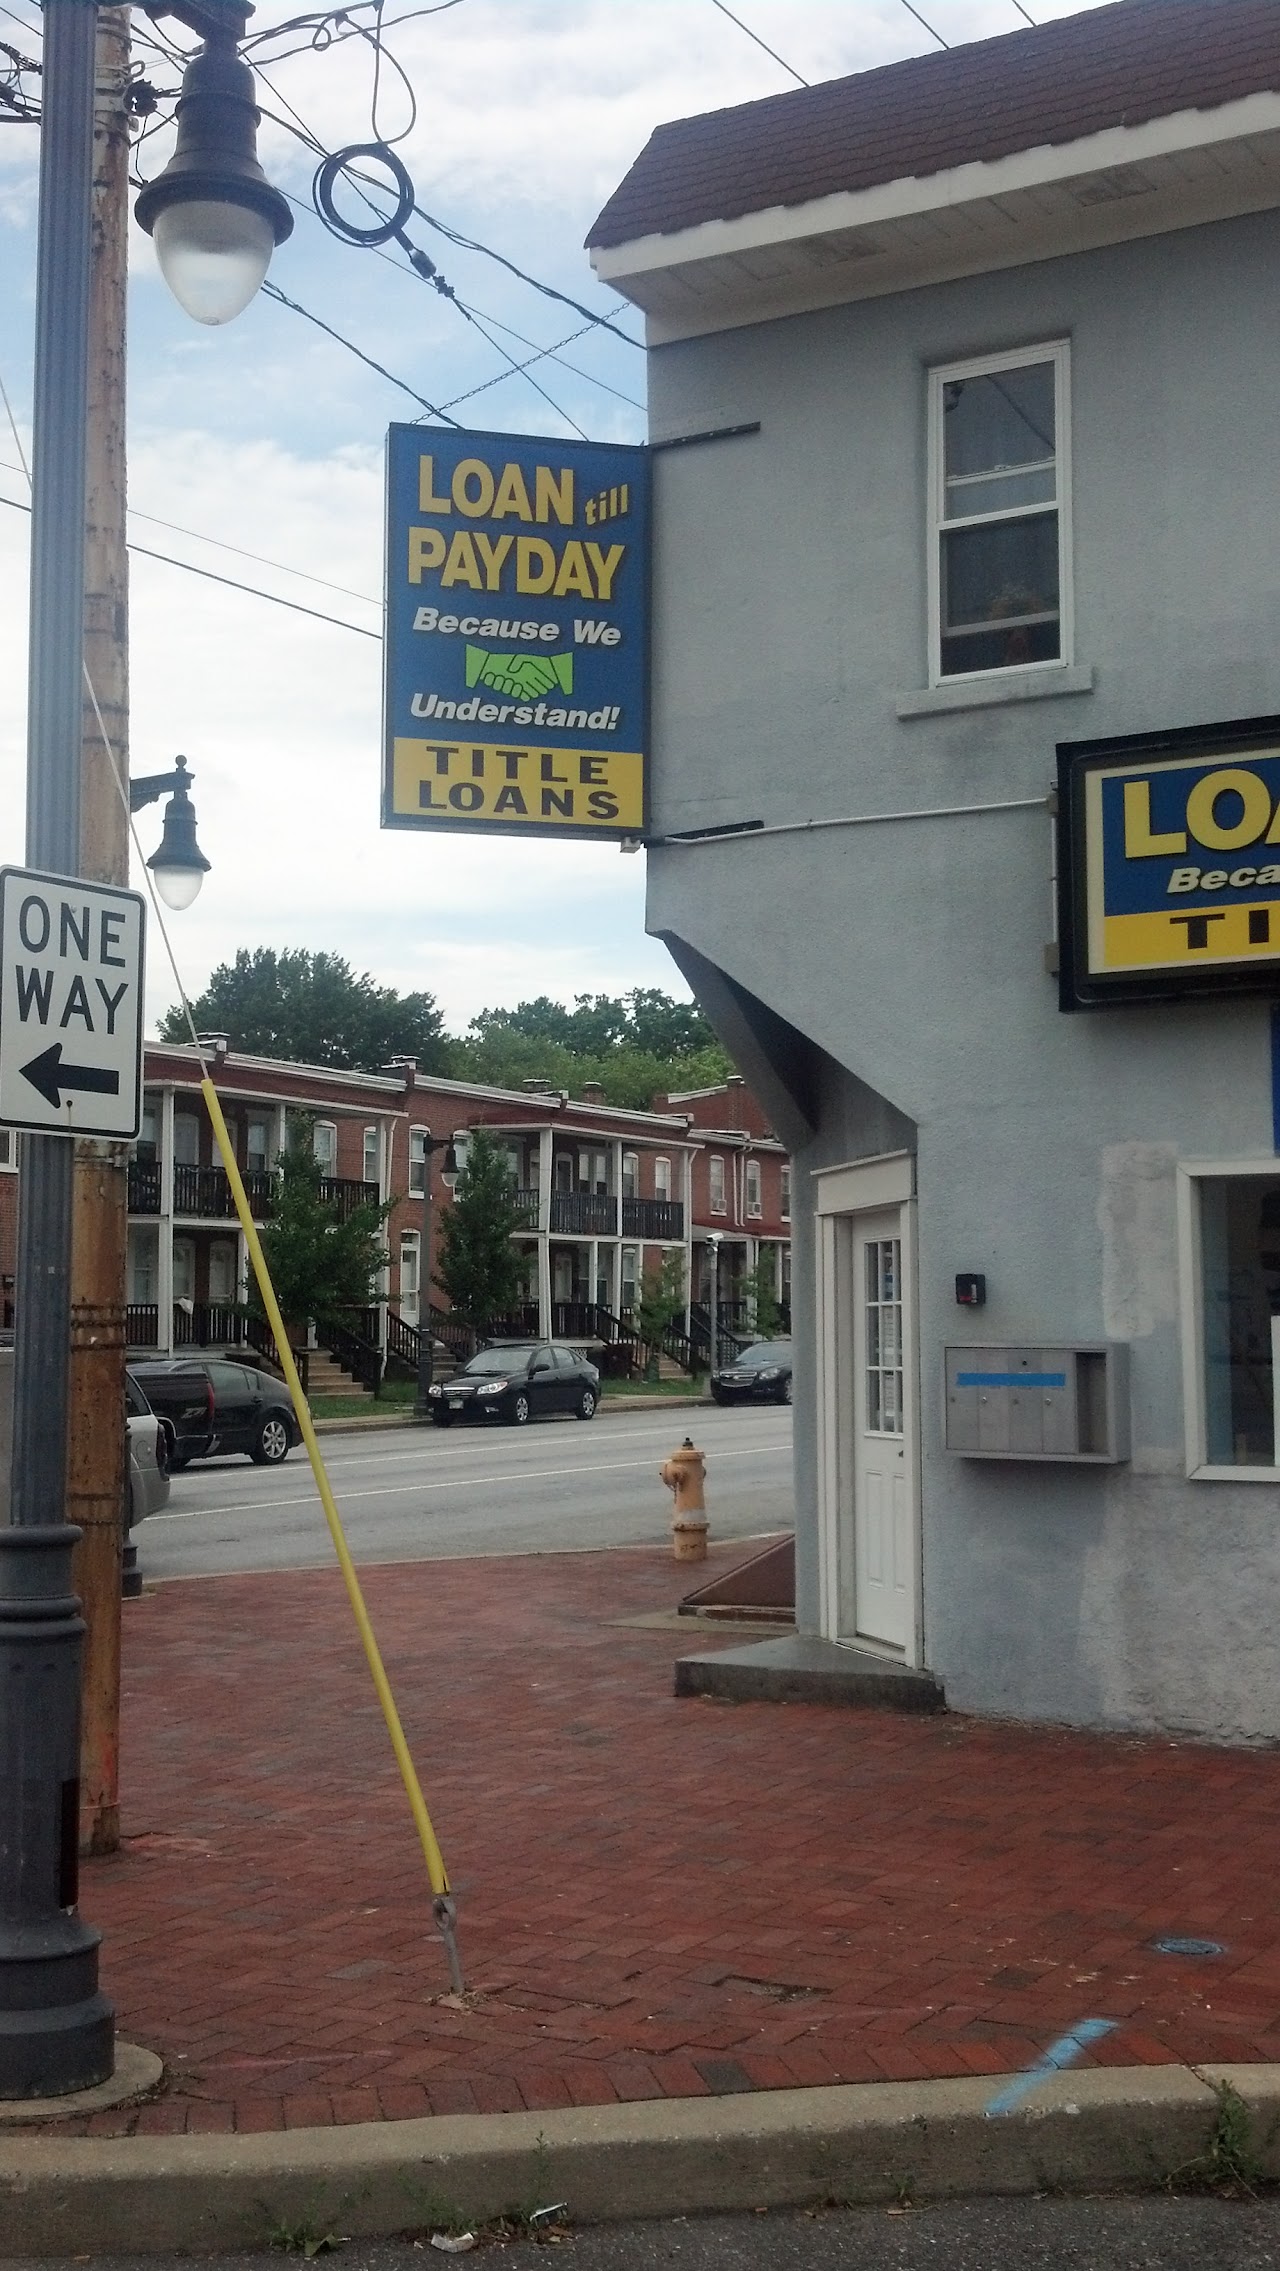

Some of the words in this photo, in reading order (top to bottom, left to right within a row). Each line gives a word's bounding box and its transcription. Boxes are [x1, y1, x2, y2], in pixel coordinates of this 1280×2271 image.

[418, 455, 575, 526] LOAN
[585, 484, 629, 527] till
[408, 526, 627, 601] PAYDAY
[413, 607, 560, 642] Because
[573, 620, 622, 646] We
[410, 693, 621, 731] Understand!
[426, 746, 609, 785] TITLE
[419, 780, 620, 820] LOANS
[19, 895, 126, 968] ONE
[15, 964, 129, 1035] WAY
